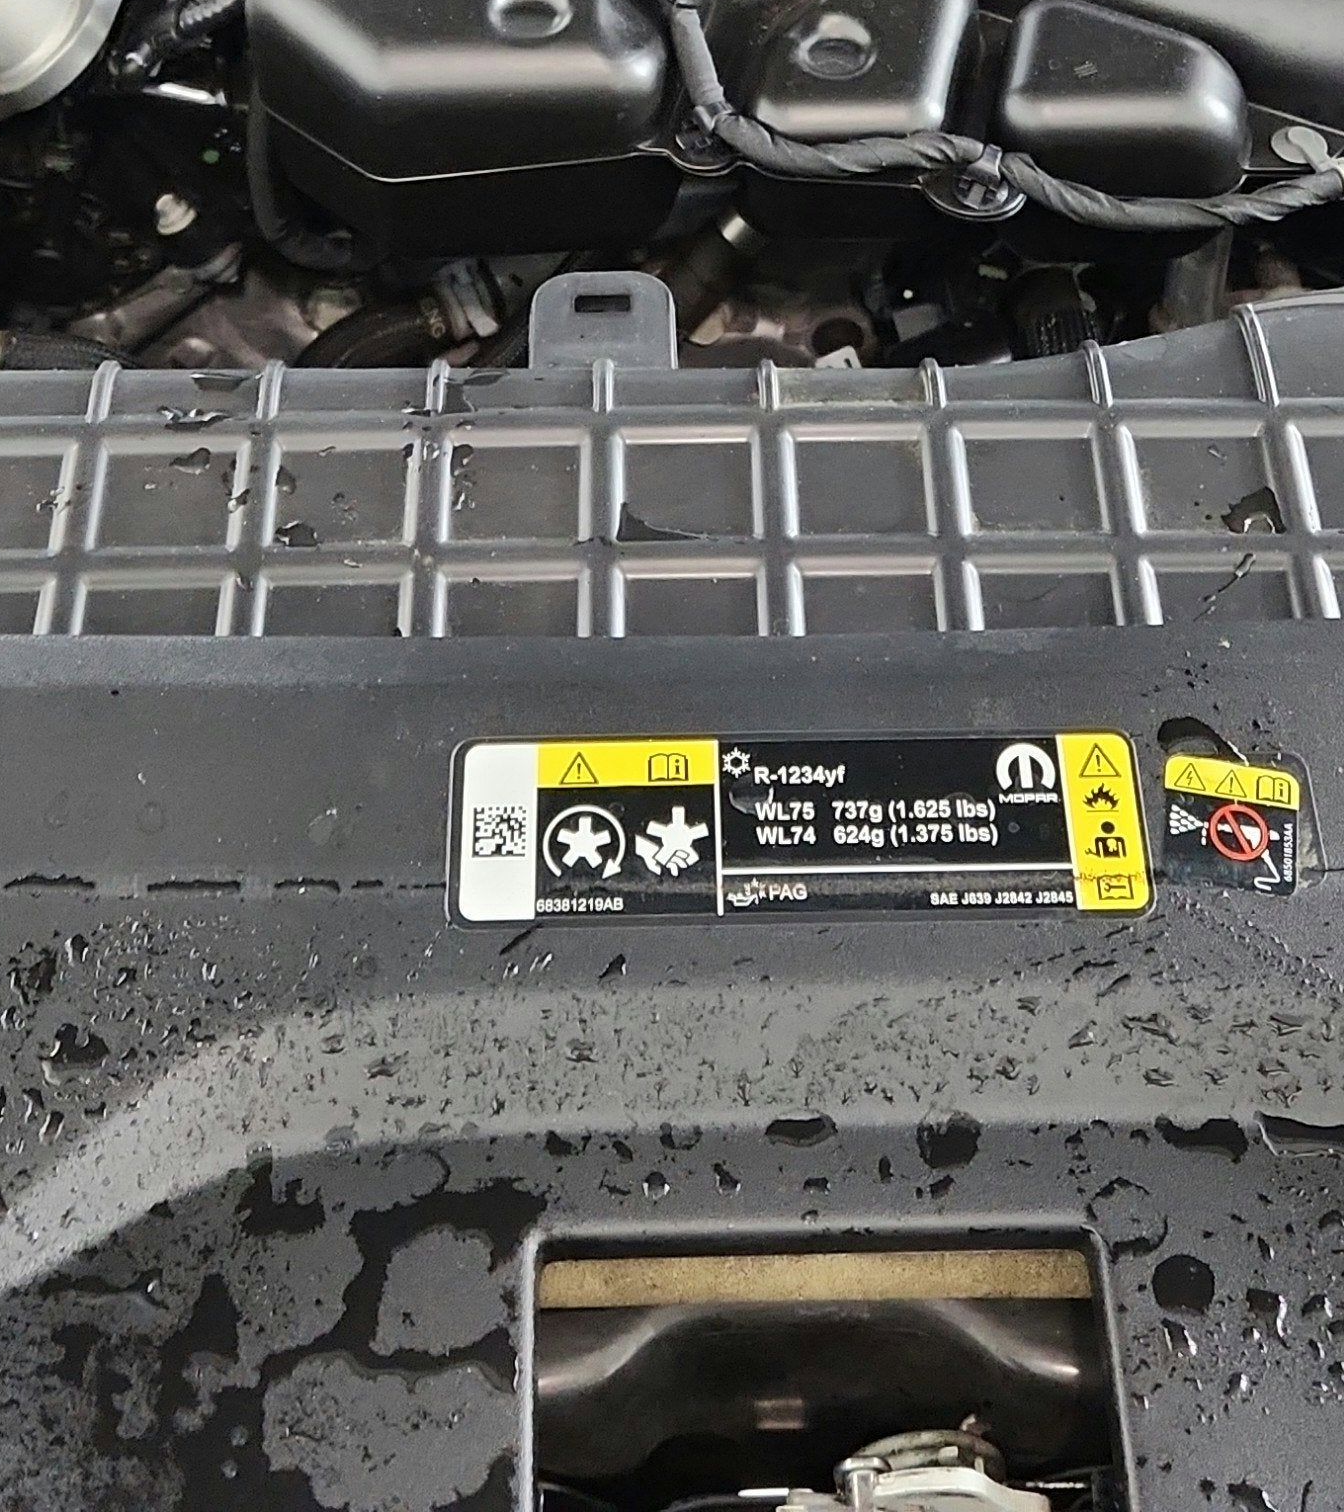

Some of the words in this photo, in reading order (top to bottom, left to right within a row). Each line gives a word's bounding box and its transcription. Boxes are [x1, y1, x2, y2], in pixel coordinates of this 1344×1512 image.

[754, 764, 846, 788] R-1234yf
[998, 792, 1058, 804] MOPAR
[755, 801, 815, 821] WL75
[831, 800, 884, 823] 737g
[888, 799, 952, 823] (1.625
[955, 798, 996, 822] lbs)
[756, 825, 817, 845] WL74
[833, 824, 885, 848] 624g
[890, 823, 954, 848] (1.375
[957, 823, 999, 847] lbs)
[768, 883, 808, 901] PAG
[929, 892, 959, 905] SAE
[994, 891, 1033, 904] J2842
[1035, 890, 1074, 904] J2845
[536, 897, 625, 913] 68381219AB
